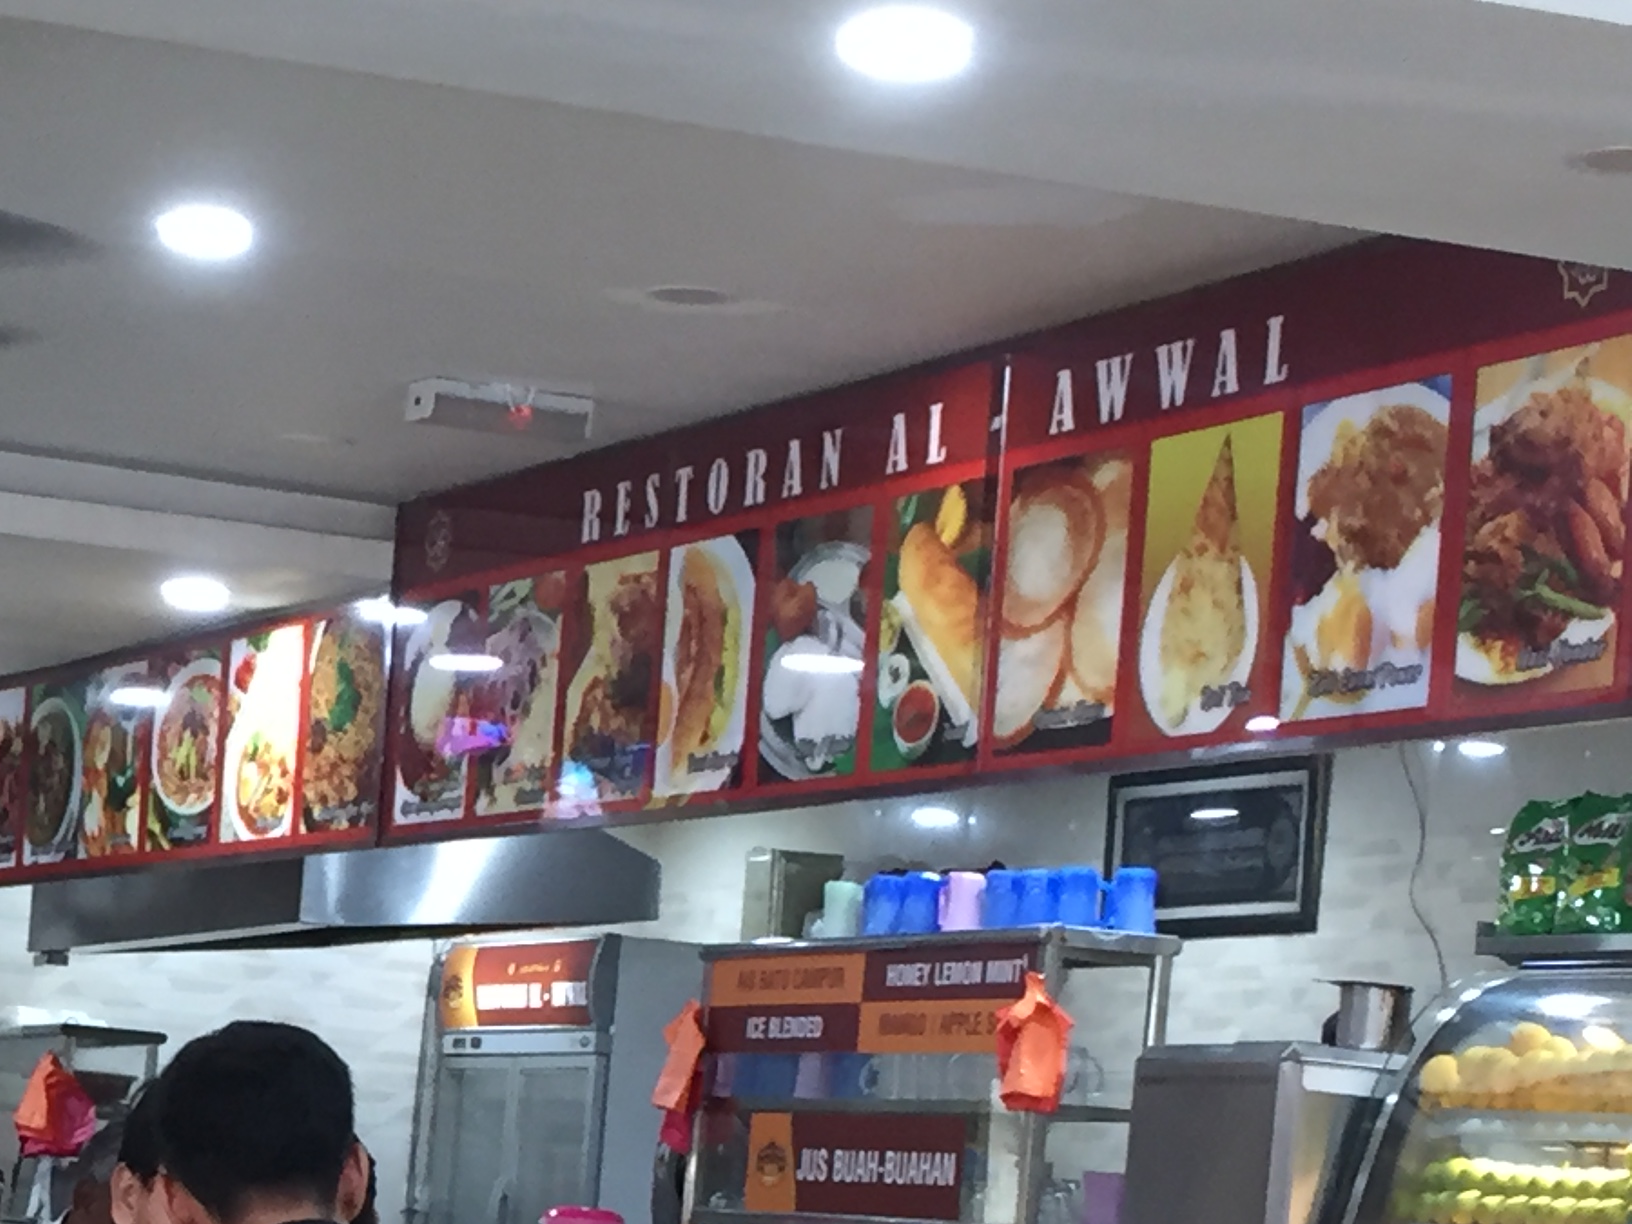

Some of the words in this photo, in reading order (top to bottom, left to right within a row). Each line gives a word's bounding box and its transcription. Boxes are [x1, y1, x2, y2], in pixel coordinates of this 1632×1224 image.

[580, 428, 844, 545] RESTORAN
[885, 402, 948, 475] AL
[1049, 315, 1290, 435] AWWAL
[885, 962, 931, 987] HONEY
[934, 961, 982, 986] LEMON
[745, 1016, 767, 1039] ICE
[768, 1015, 823, 1039] BLENDED
[796, 1147, 829, 1182] JUS
[831, 1148, 958, 1187] BUAH-BUAHAN
